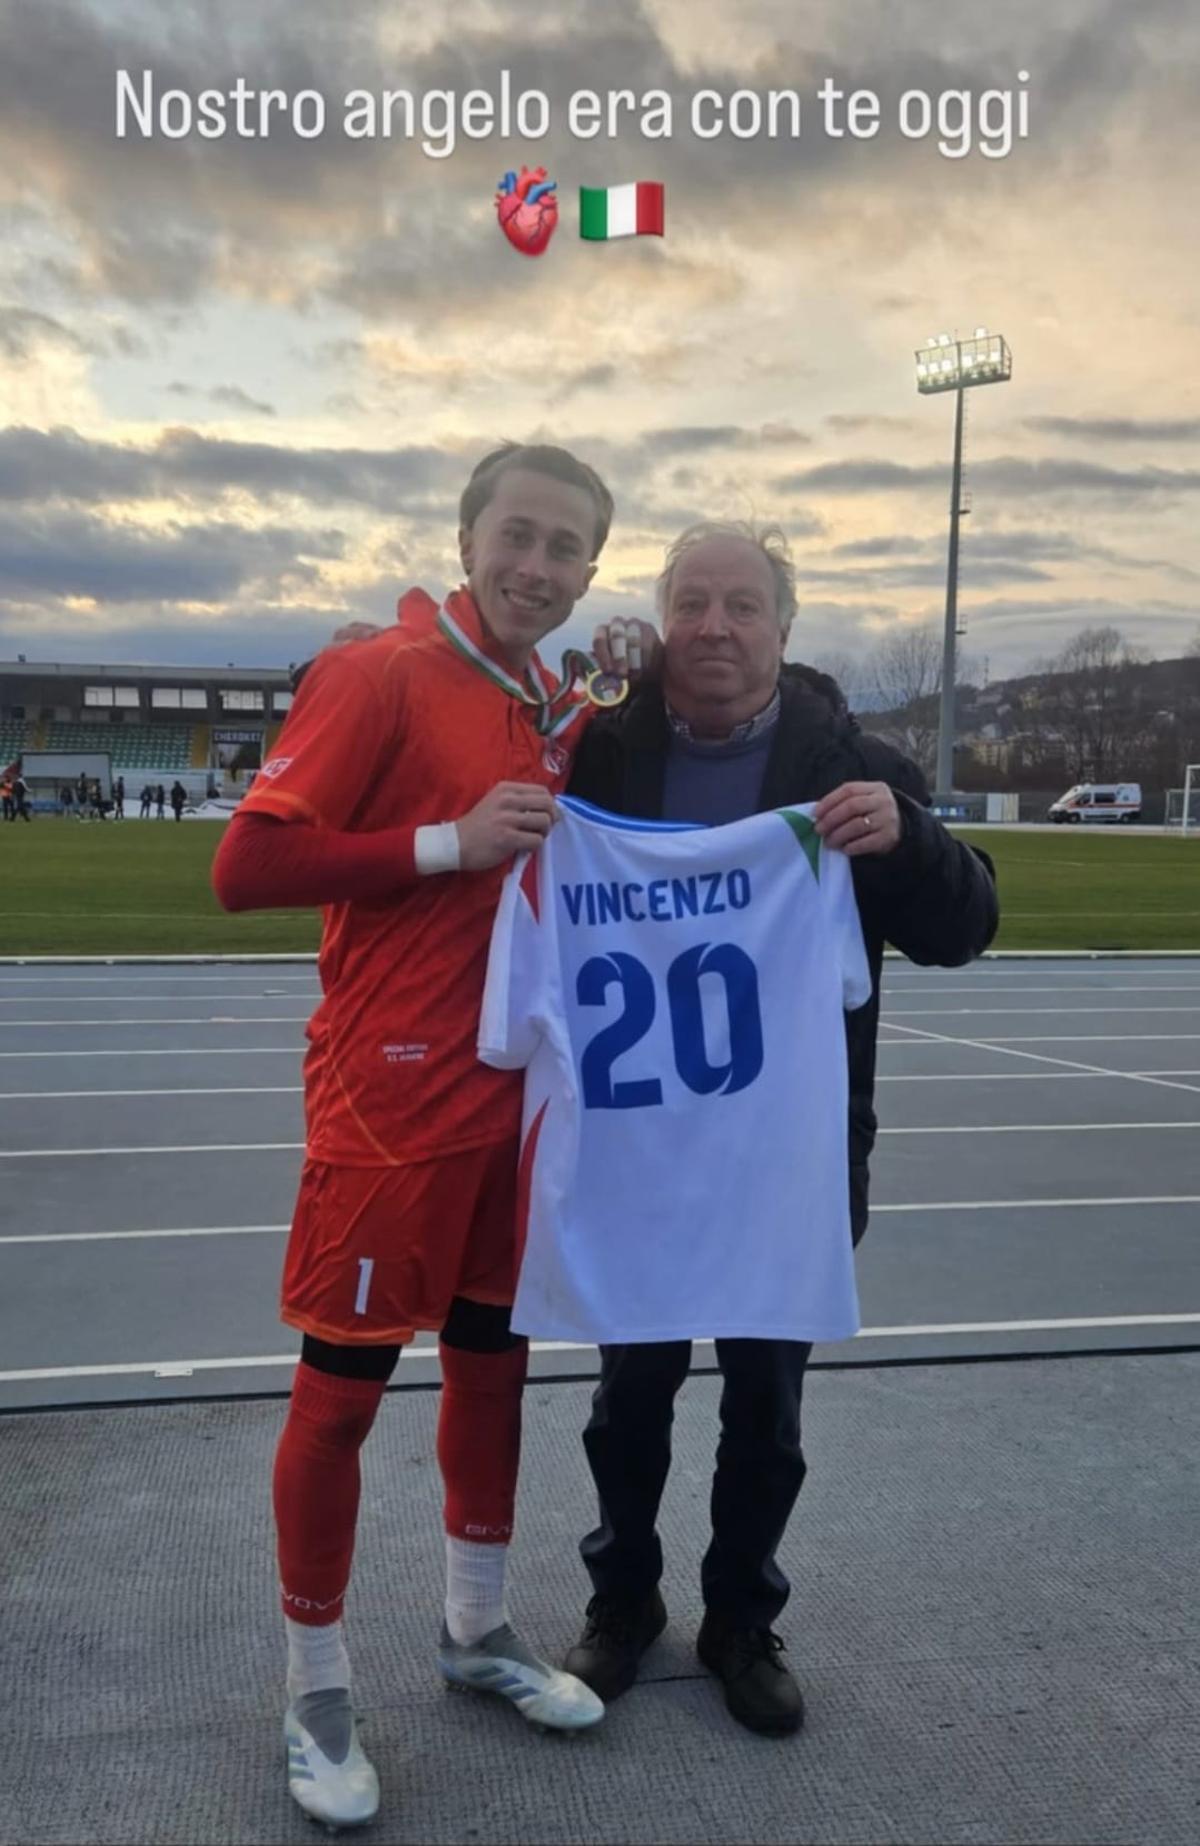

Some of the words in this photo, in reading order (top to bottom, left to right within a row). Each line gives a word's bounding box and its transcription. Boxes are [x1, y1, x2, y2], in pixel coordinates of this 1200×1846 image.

[561, 869, 751, 925] VINCENZO
[576, 942, 763, 1109] 20
[355, 1258, 373, 1314] 1
